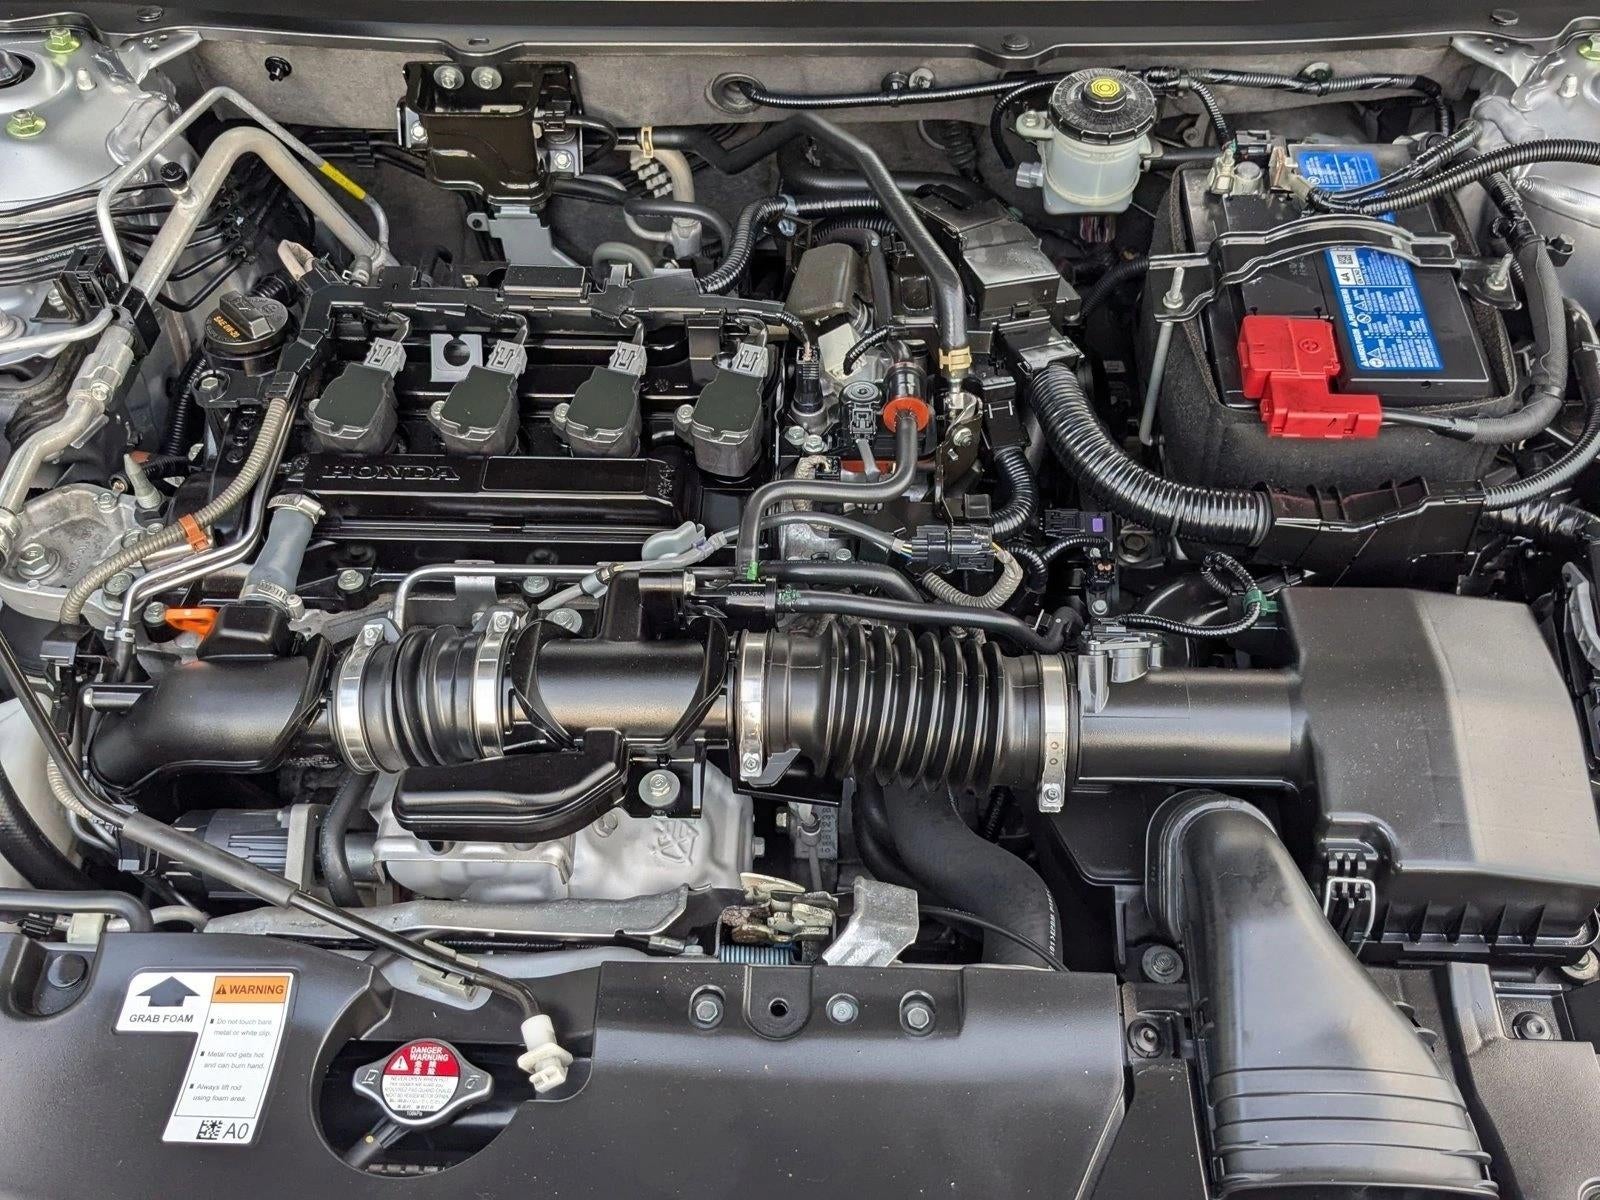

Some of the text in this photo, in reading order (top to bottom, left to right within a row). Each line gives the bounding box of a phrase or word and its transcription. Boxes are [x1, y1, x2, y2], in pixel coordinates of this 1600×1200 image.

[322, 465, 461, 481] HONDA
[228, 984, 285, 995] WARNING
[129, 1014, 194, 1023] GRAB FOAM
[410, 1046, 443, 1054] DANGER
[207, 1050, 225, 1058] Metal
[238, 1051, 252, 1060] gets
[410, 1053, 449, 1061] WARNUNG
[246, 1062, 265, 1070] hand.
[196, 1083, 220, 1092] Always
[192, 1094, 211, 1102] using
[211, 1094, 229, 1102] foam
[222, 1122, 249, 1140] A0
